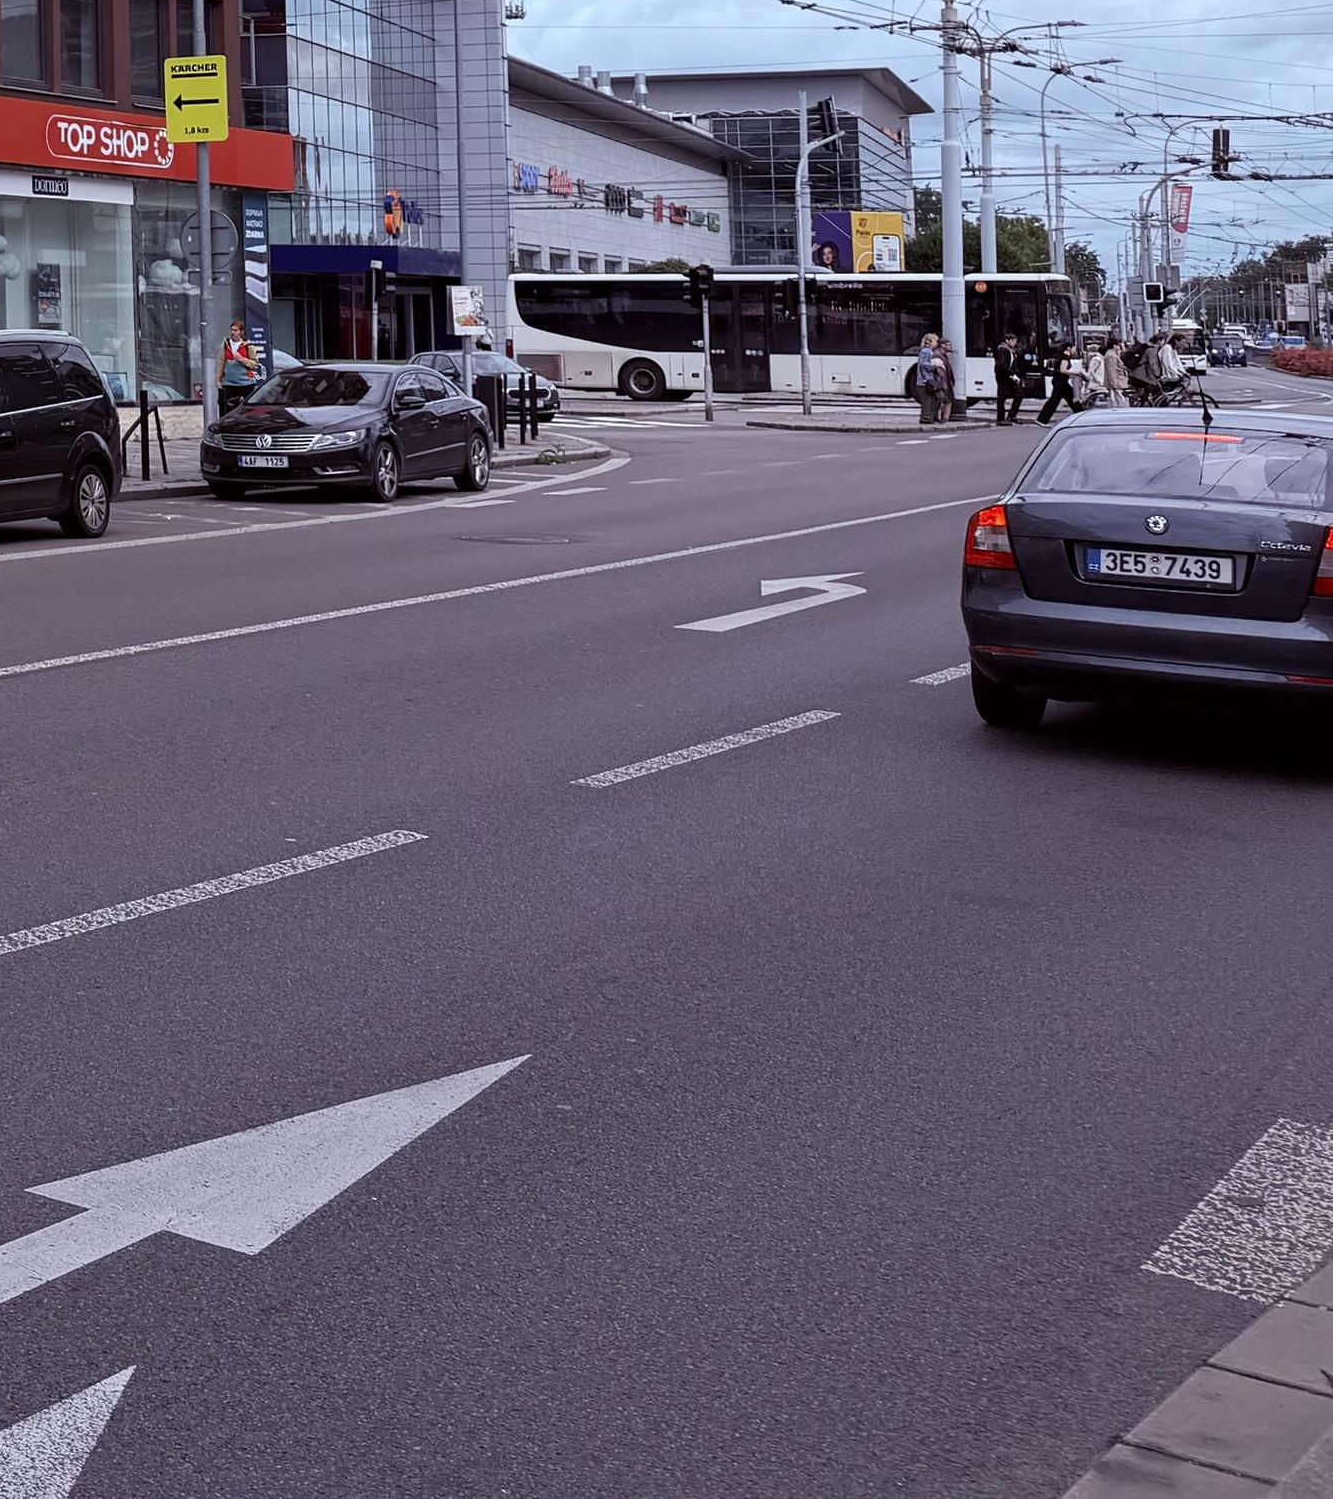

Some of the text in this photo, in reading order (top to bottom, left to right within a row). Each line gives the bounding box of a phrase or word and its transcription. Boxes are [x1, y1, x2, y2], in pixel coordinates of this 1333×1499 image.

[196, 126, 210, 134] km
[57, 121, 150, 159] TOP SHOP
[264, 457, 285, 467] 1125
[1260, 540, 1312, 551] Octavia
[1105, 552, 1222, 580] 3E5 7439
